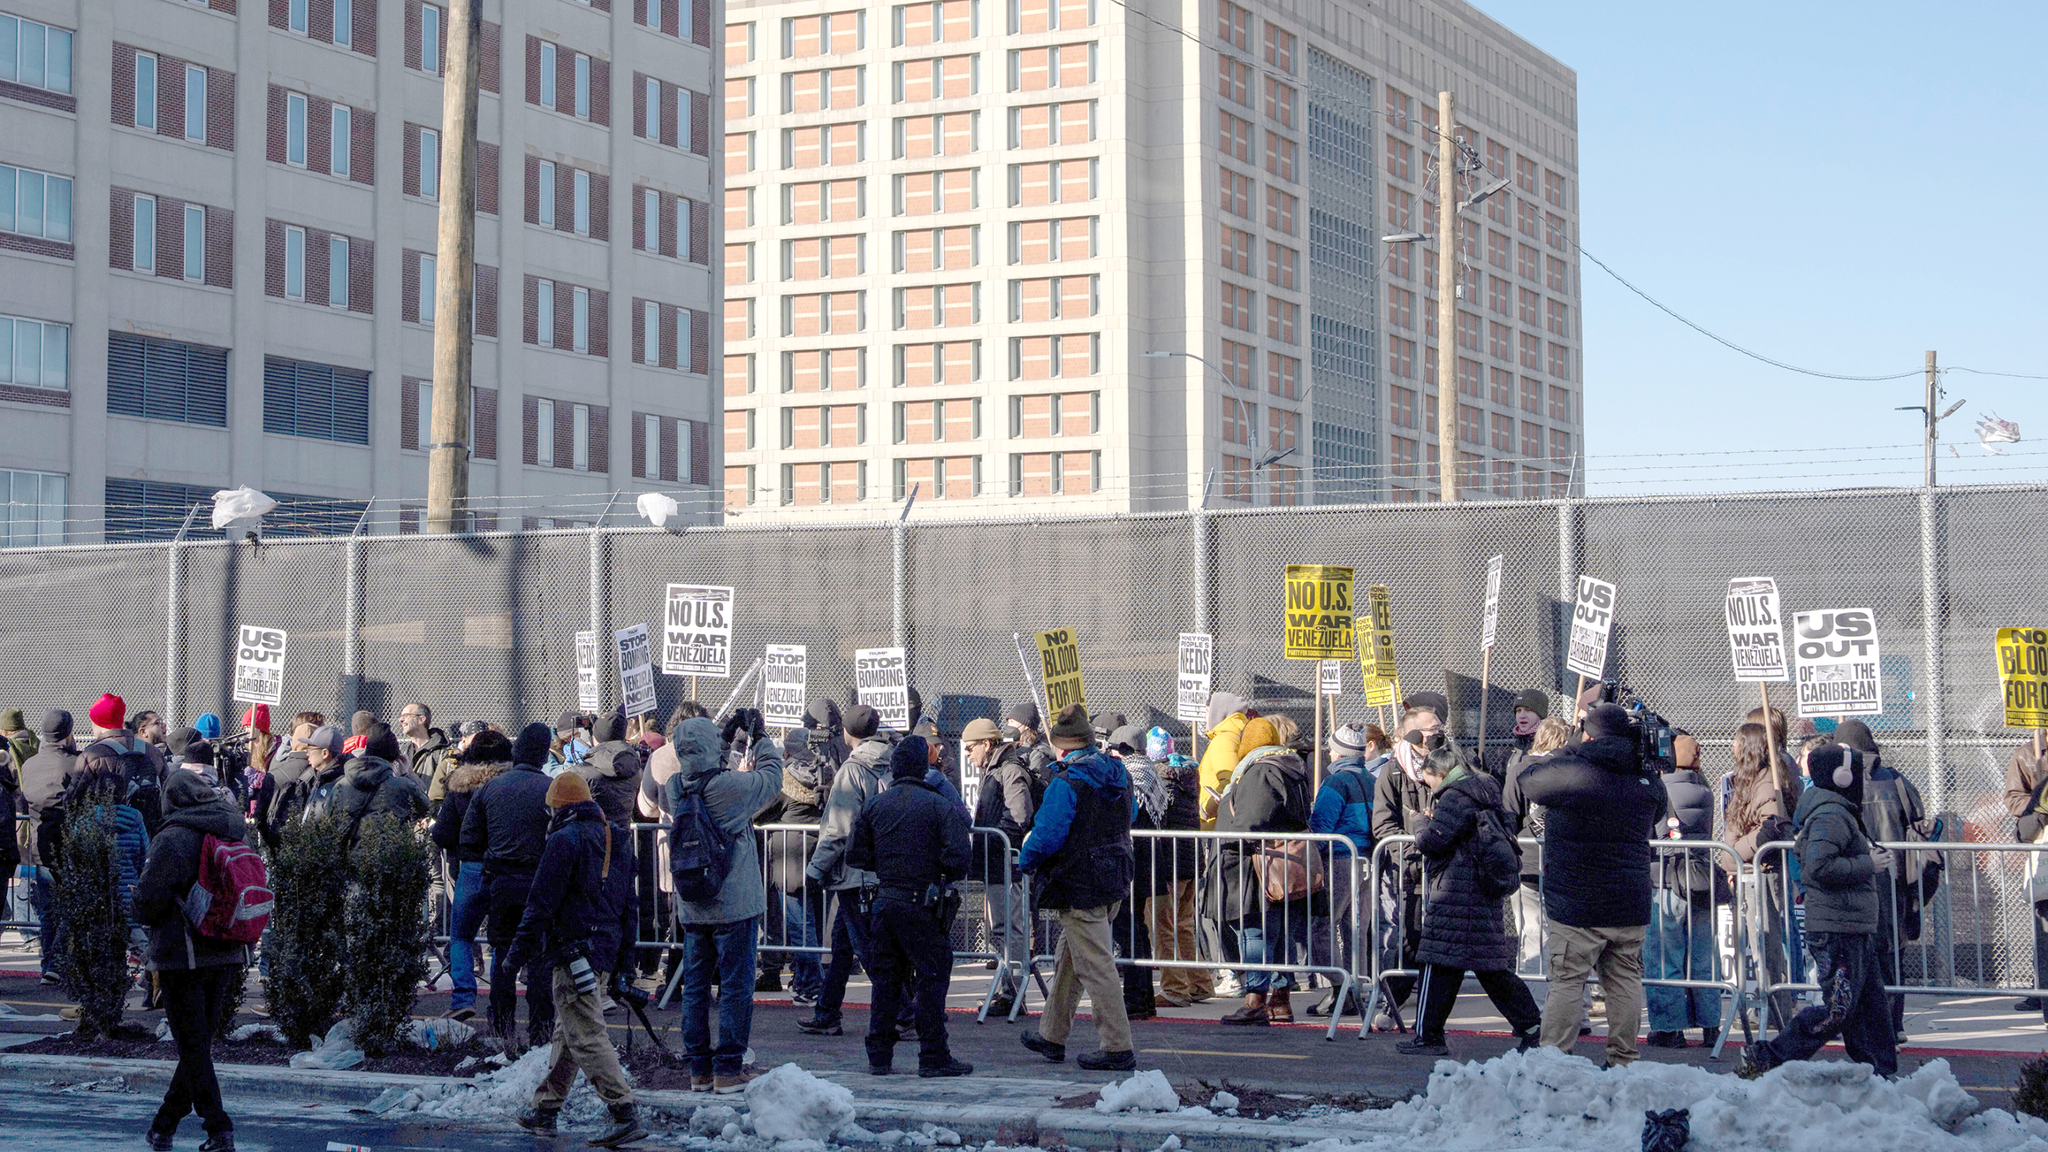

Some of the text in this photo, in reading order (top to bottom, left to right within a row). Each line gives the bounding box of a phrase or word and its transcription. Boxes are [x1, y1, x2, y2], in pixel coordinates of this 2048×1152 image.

[1288, 582, 1352, 611] NO U.S.
[1580, 579, 1612, 609] US
[668, 600, 728, 628] NO U.S.
[1371, 601, 1390, 630] NEE
[1576, 604, 1609, 626] OUT
[1728, 596, 1777, 626] NO U.S.
[1288, 614, 1352, 629] WAR
[1798, 612, 1872, 639] US
[242, 629, 282, 650] US
[620, 633, 646, 652] STOP
[668, 632, 727, 647] WAR
[1044, 630, 1068, 646] NO
[1288, 629, 1352, 648] VENEZUELA
[1375, 635, 1394, 646] NO
[1595, 632, 1606, 648] THE
[1732, 632, 1780, 646] WAR
[2012, 630, 2047, 644] NO
[240, 648, 282, 664] OUT
[667, 646, 726, 664] VENEZUELA
[1735, 648, 1782, 666] VENEZUELA
[1798, 640, 1874, 659] OUT
[768, 654, 804, 664] STOP
[858, 658, 902, 669] STOP
[1042, 644, 1078, 678] BLOOD
[1180, 648, 1209, 675] NEEDS
[2001, 646, 2048, 676] BLOO
[238, 665, 280, 680] OF THE
[767, 665, 804, 684] BOMBING
[858, 669, 904, 688] BOMBING
[1322, 669, 1338, 680] OW!
[1363, 664, 1376, 676] NO
[1800, 666, 1814, 682] OF
[1853, 663, 1876, 680] THE
[238, 677, 279, 694] CARIBBEAN
[1046, 677, 1084, 710] FOR OIL
[1180, 680, 1202, 690] NOT
[1801, 680, 1876, 702] CARIBBEAN
[2006, 680, 2038, 708] FOR
[766, 688, 802, 704] VENEZUELA
[860, 691, 906, 707] VENEZUELA
[766, 704, 802, 716] NOW!
[878, 708, 906, 718] OW!
